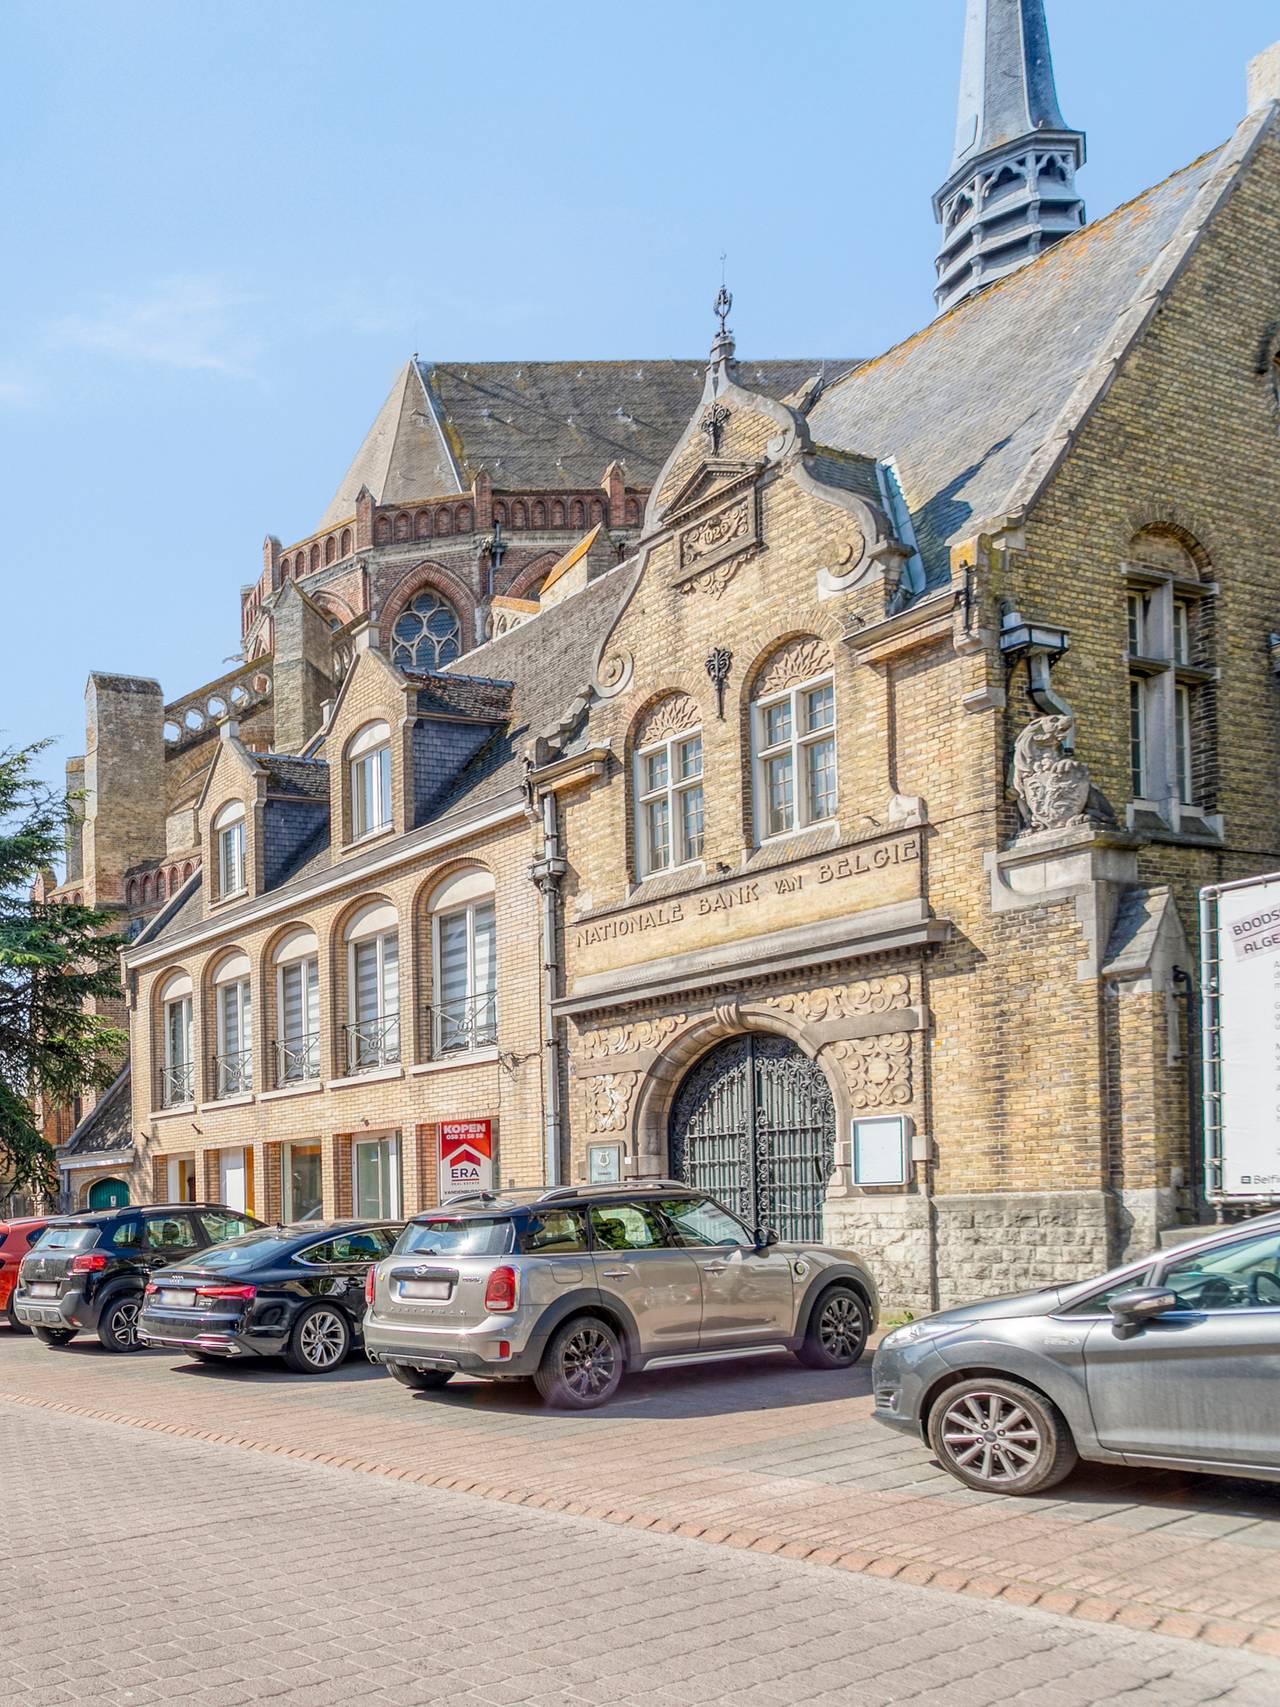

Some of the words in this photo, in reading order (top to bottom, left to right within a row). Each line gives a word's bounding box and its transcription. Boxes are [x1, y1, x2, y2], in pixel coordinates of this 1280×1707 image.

[576, 903, 685, 947] NATIONALE
[698, 881, 760, 917] BANK
[774, 874, 804, 896] VAN
[818, 839, 921, 884] BELGIE
[443, 1123, 486, 1134] KOPEN
[451, 1167, 480, 1179] ERA
